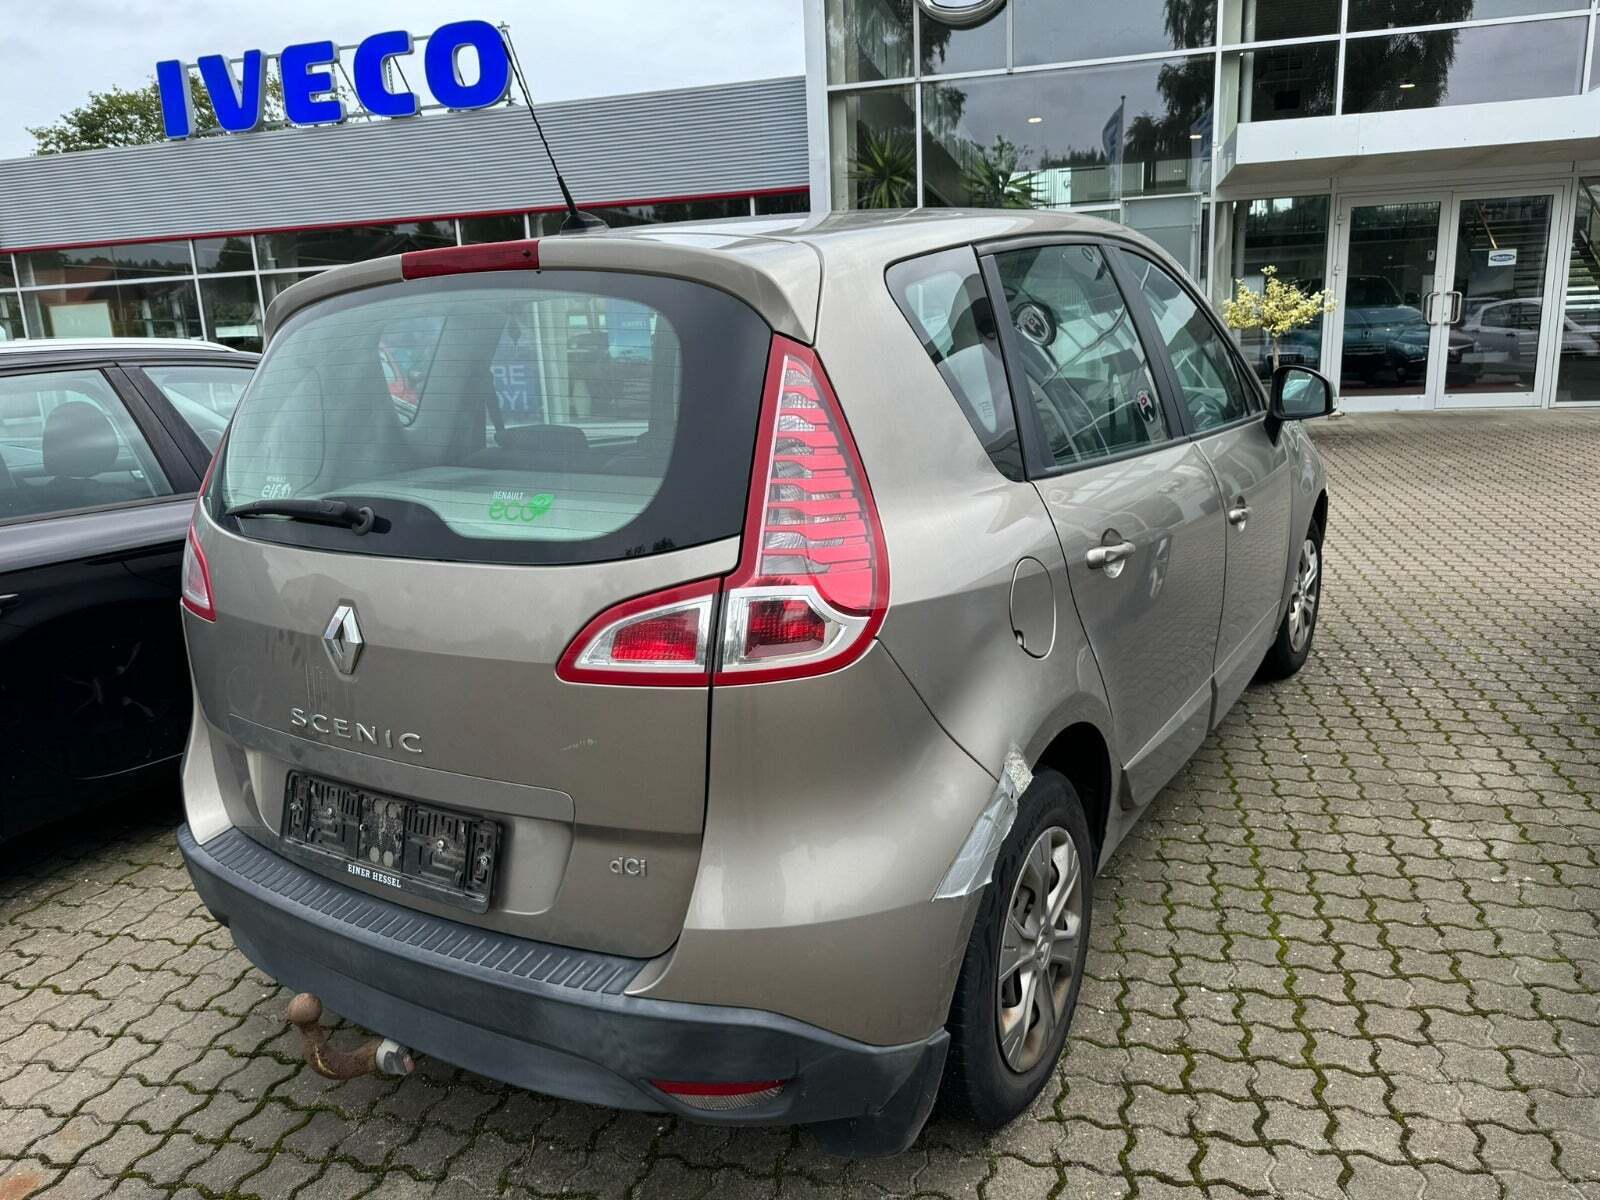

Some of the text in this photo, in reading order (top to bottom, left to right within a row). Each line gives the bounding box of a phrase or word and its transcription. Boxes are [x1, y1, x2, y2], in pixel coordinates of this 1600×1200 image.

[156, 20, 511, 140] IVECO
[493, 490, 524, 501] RENAULT
[291, 707, 423, 753] SCENIC
[347, 863, 402, 888] EJNER HESSEL
[609, 856, 646, 877] dCi
